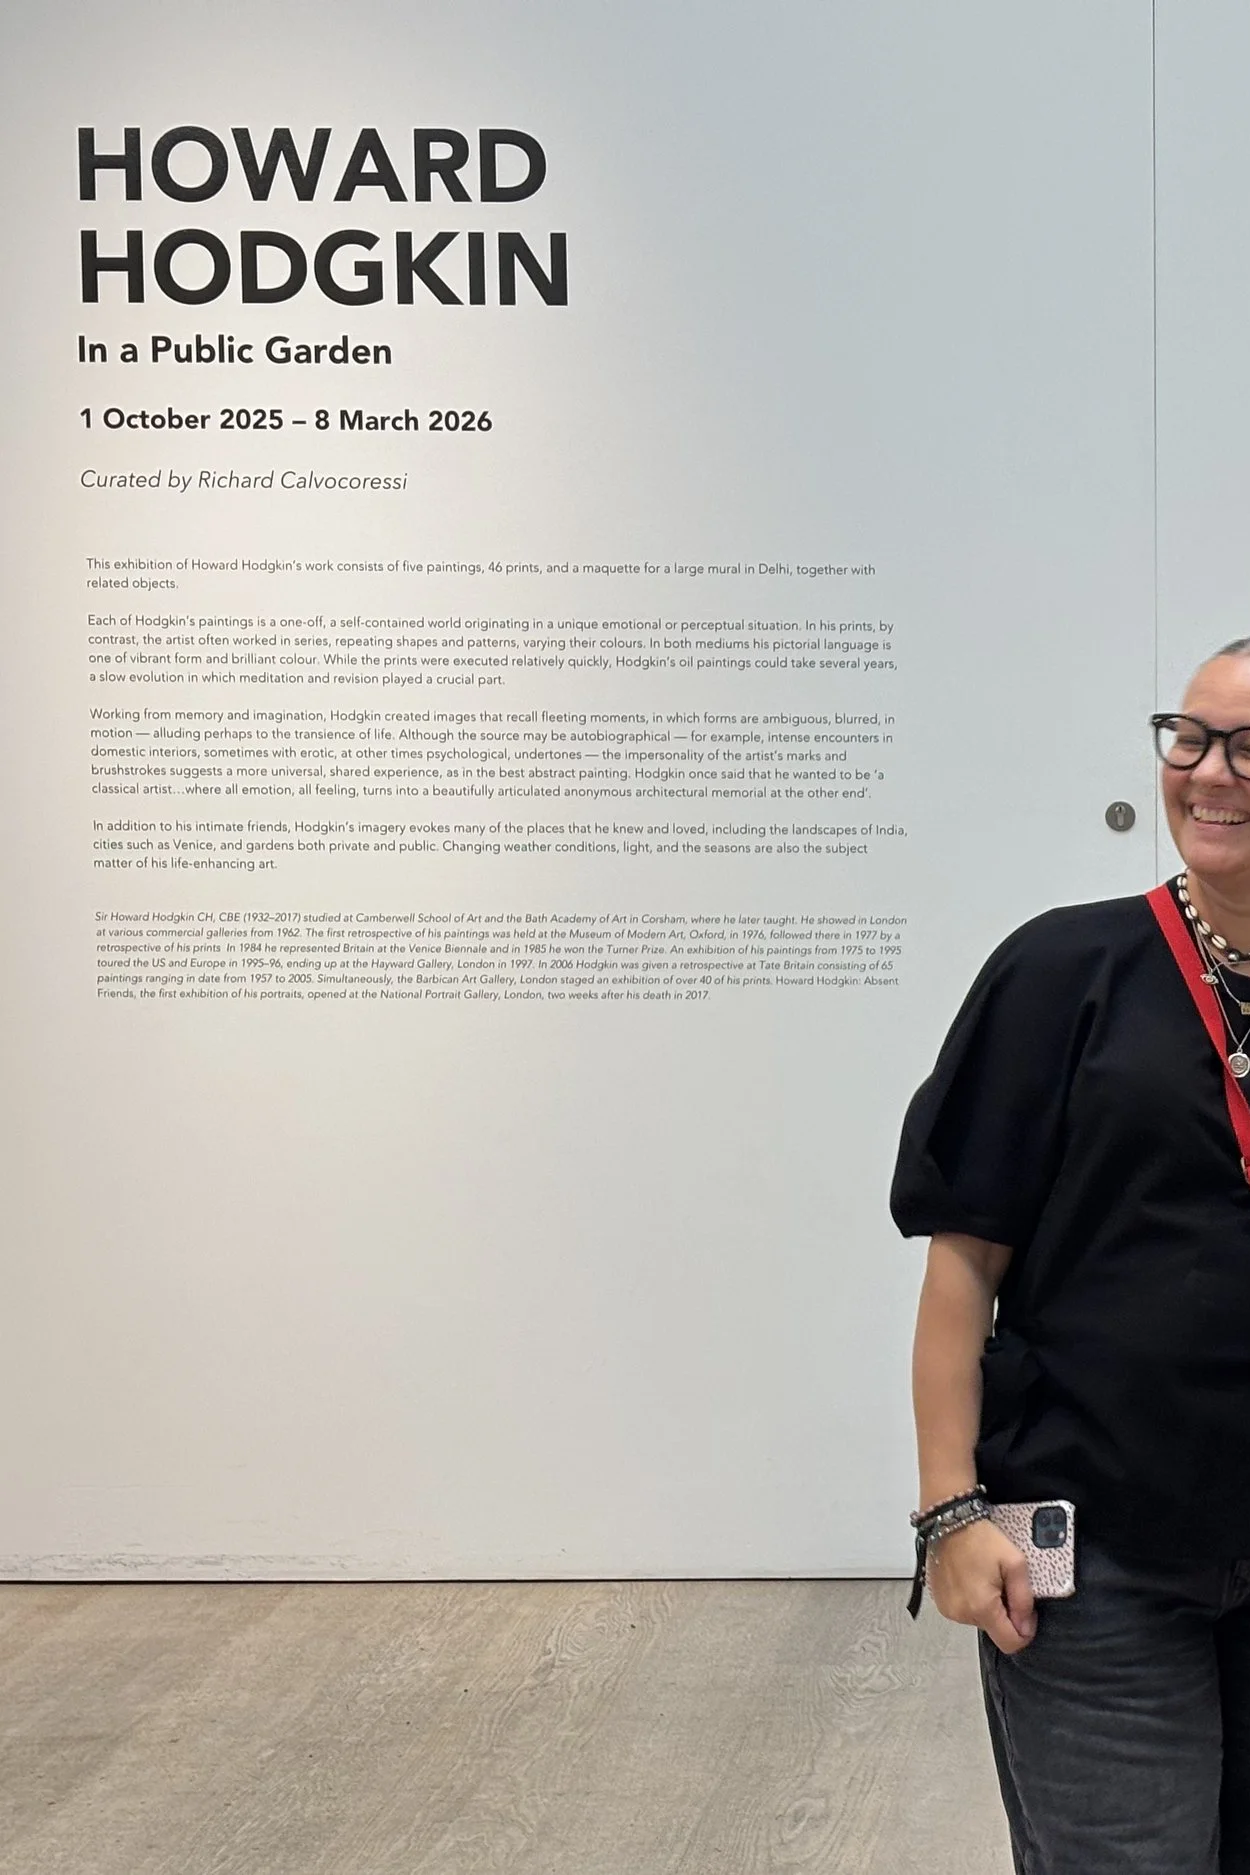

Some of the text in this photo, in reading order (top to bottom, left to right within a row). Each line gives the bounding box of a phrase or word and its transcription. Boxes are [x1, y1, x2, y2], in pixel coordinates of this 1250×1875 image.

[78, 126, 546, 202] HOWARD
[81, 229, 568, 306] HODGKIN
[78, 333, 392, 365] In a Public Garden
[79, 407, 92, 430] 1
[102, 406, 212, 430] October
[219, 407, 284, 431] 2025
[314, 408, 331, 431] 8
[339, 408, 420, 432] March
[428, 409, 493, 433] 2026
[80, 468, 408, 493] Curated by Richard Calvocoressi
[85, 557, 876, 579] This exhibition of Howard Hodgkin’s work consists of five paintings, 46 prints, and a maquette for a large mural in Delhi, together with
[86, 575, 179, 592] related objects.
[87, 613, 894, 635] Each of Hodgkin’s paintings is a one-off, a self-contained world originating in a unique emotional or perceptual situation. In his prints, by
[89, 669, 506, 689] a slow evolution in which meditation and revision played a crucial part.
[89, 707, 895, 728] Working from memory and imagination, Hodgkin created images that recall fleeting moments, in which forms are ambiguous, blurred, in
[92, 818, 908, 839] In addition to his intimate friends, Hodgkin’s imagery evokes many of the places that he knew and loved, including the landscapes of India,
[93, 855, 278, 873] matter of his life-enhancing art.
[97, 987, 137, 1000] Friends,
[139, 987, 156, 999] the
[158, 987, 177, 999] first
[179, 987, 229, 999] exhibition
[230, 987, 243, 999] of
[243, 988, 258, 999] his
[259, 990, 305, 1001] portraits,
[307, 988, 348, 1001] opened
[348, 990, 359, 999] at
[361, 988, 378, 1000] the
[379, 988, 423, 1000] National
[424, 988, 461, 1000] Portrait
[463, 988, 501, 1002] Gallery,
[503, 989, 545, 1001] London,
[547, 991, 566, 1000] two
[568, 989, 599, 1000] weeks
[600, 989, 625, 1000] after
[626, 989, 641, 1000] his
[642, 989, 672, 1001] death
[673, 990, 683, 1000] in
